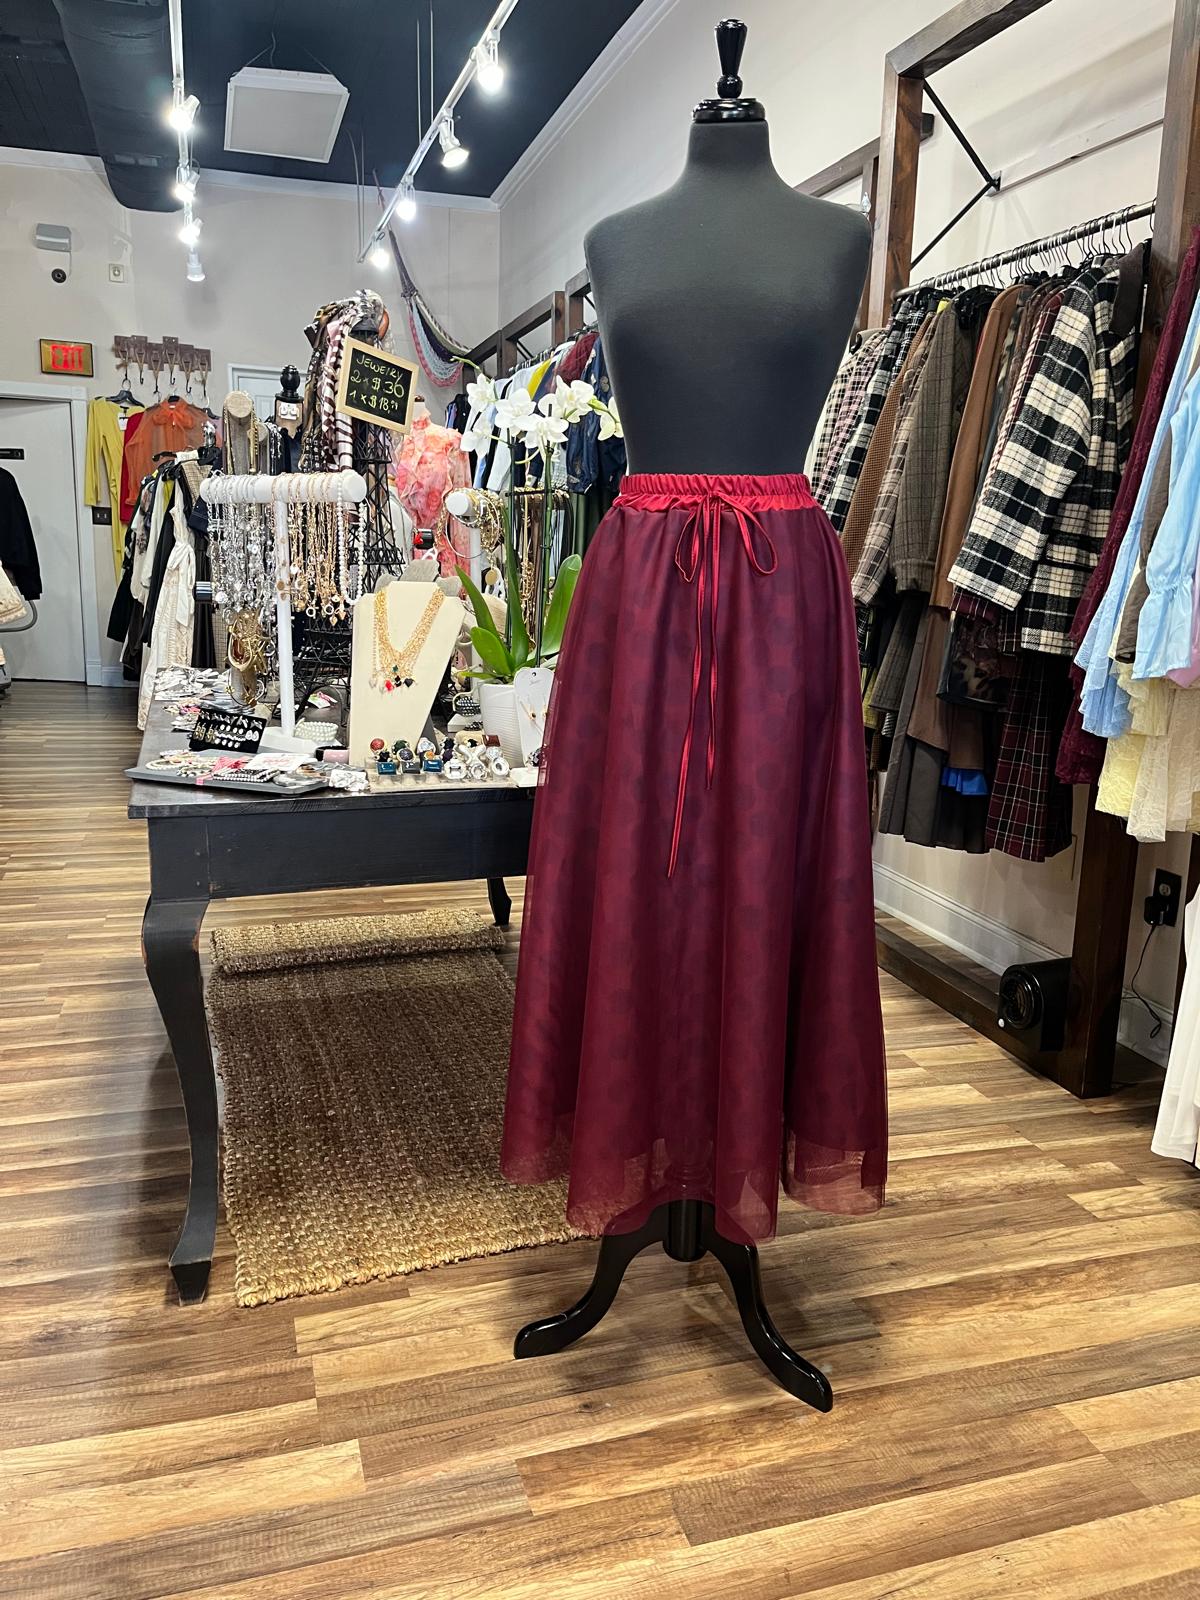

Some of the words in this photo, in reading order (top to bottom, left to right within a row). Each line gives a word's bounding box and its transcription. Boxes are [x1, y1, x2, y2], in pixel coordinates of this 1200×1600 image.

[51, 344, 84, 371] EXIT
[350, 369, 362, 383] 2
[349, 390, 357, 401] 1
